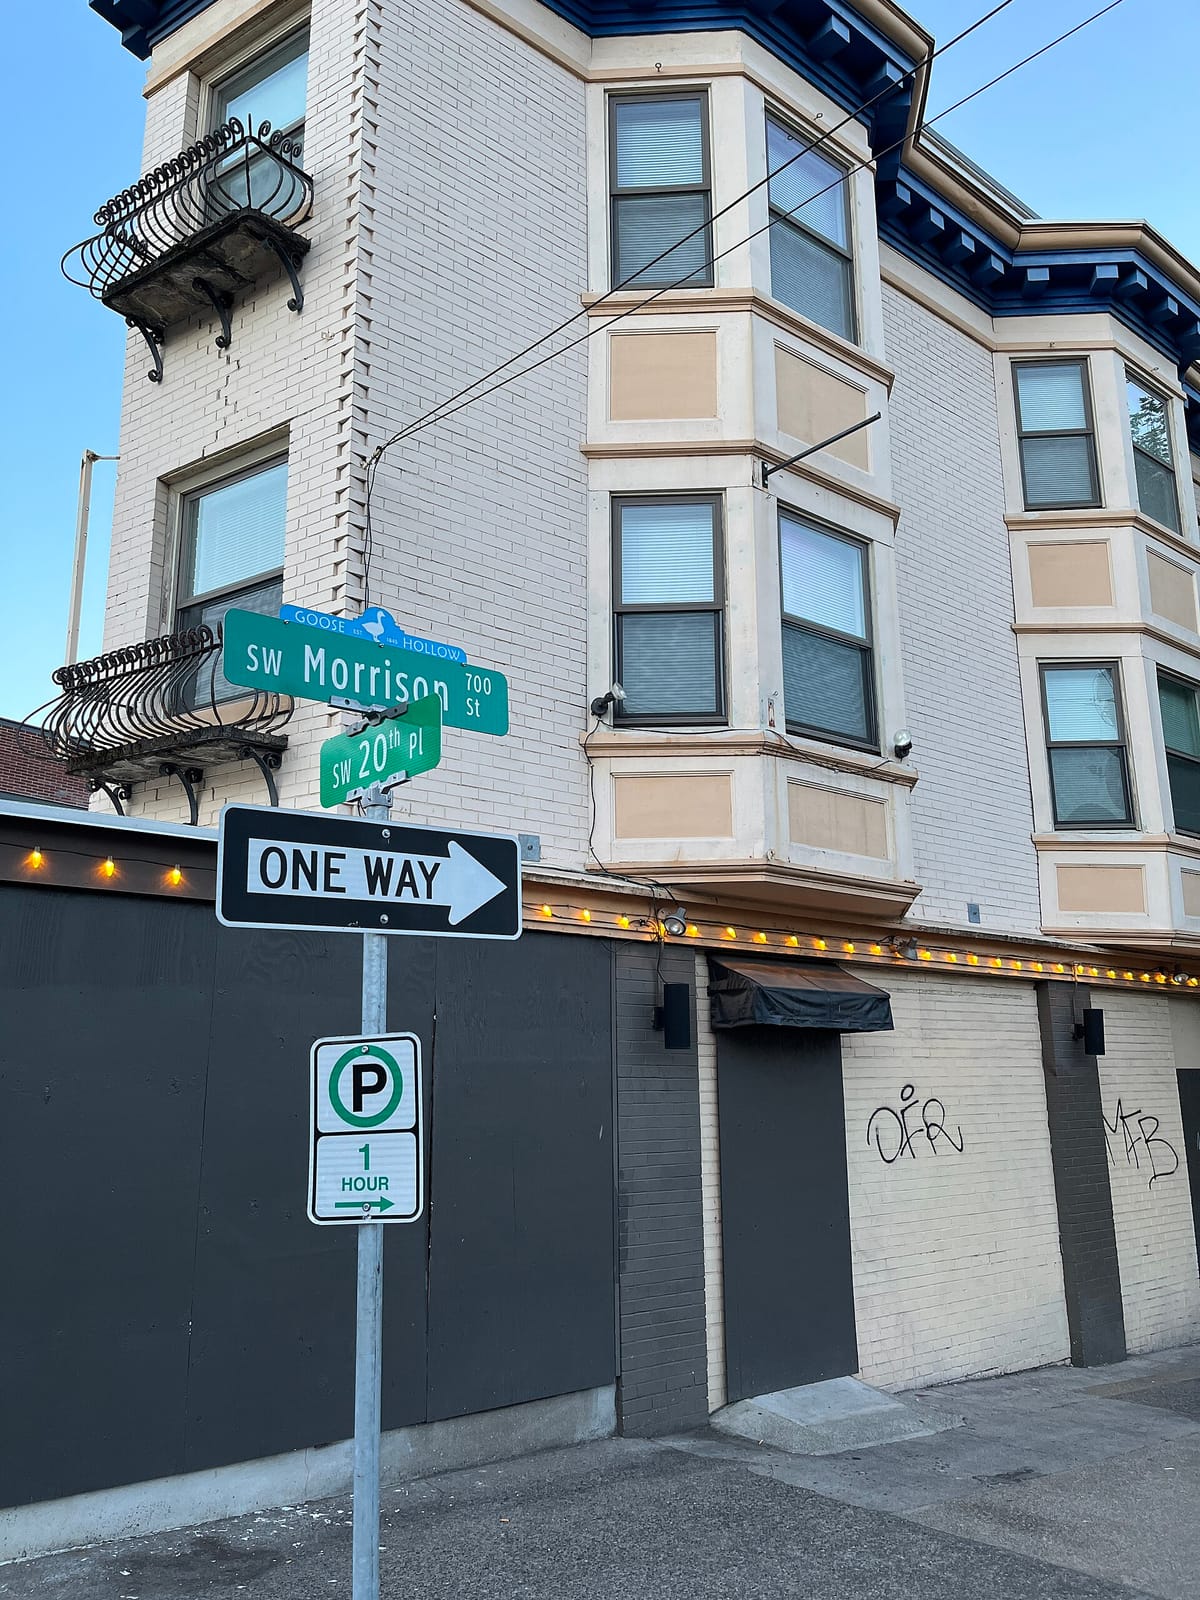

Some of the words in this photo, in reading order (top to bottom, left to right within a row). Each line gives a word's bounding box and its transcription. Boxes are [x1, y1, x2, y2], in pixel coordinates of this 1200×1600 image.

[294, 610, 345, 634] GOOSE
[403, 637, 460, 661] HOLLOW
[246, 643, 282, 676] SW
[304, 644, 449, 712] Morrison
[465, 672, 492, 696] 700
[466, 697, 481, 718] St
[332, 758, 351, 789] SW
[358, 729, 400, 779] 20th
[259, 846, 347, 894] ONE
[363, 855, 441, 900] WAY
[352, 1063, 388, 1113] P
[358, 1143, 370, 1171] 1
[341, 1176, 389, 1192] HOUR
